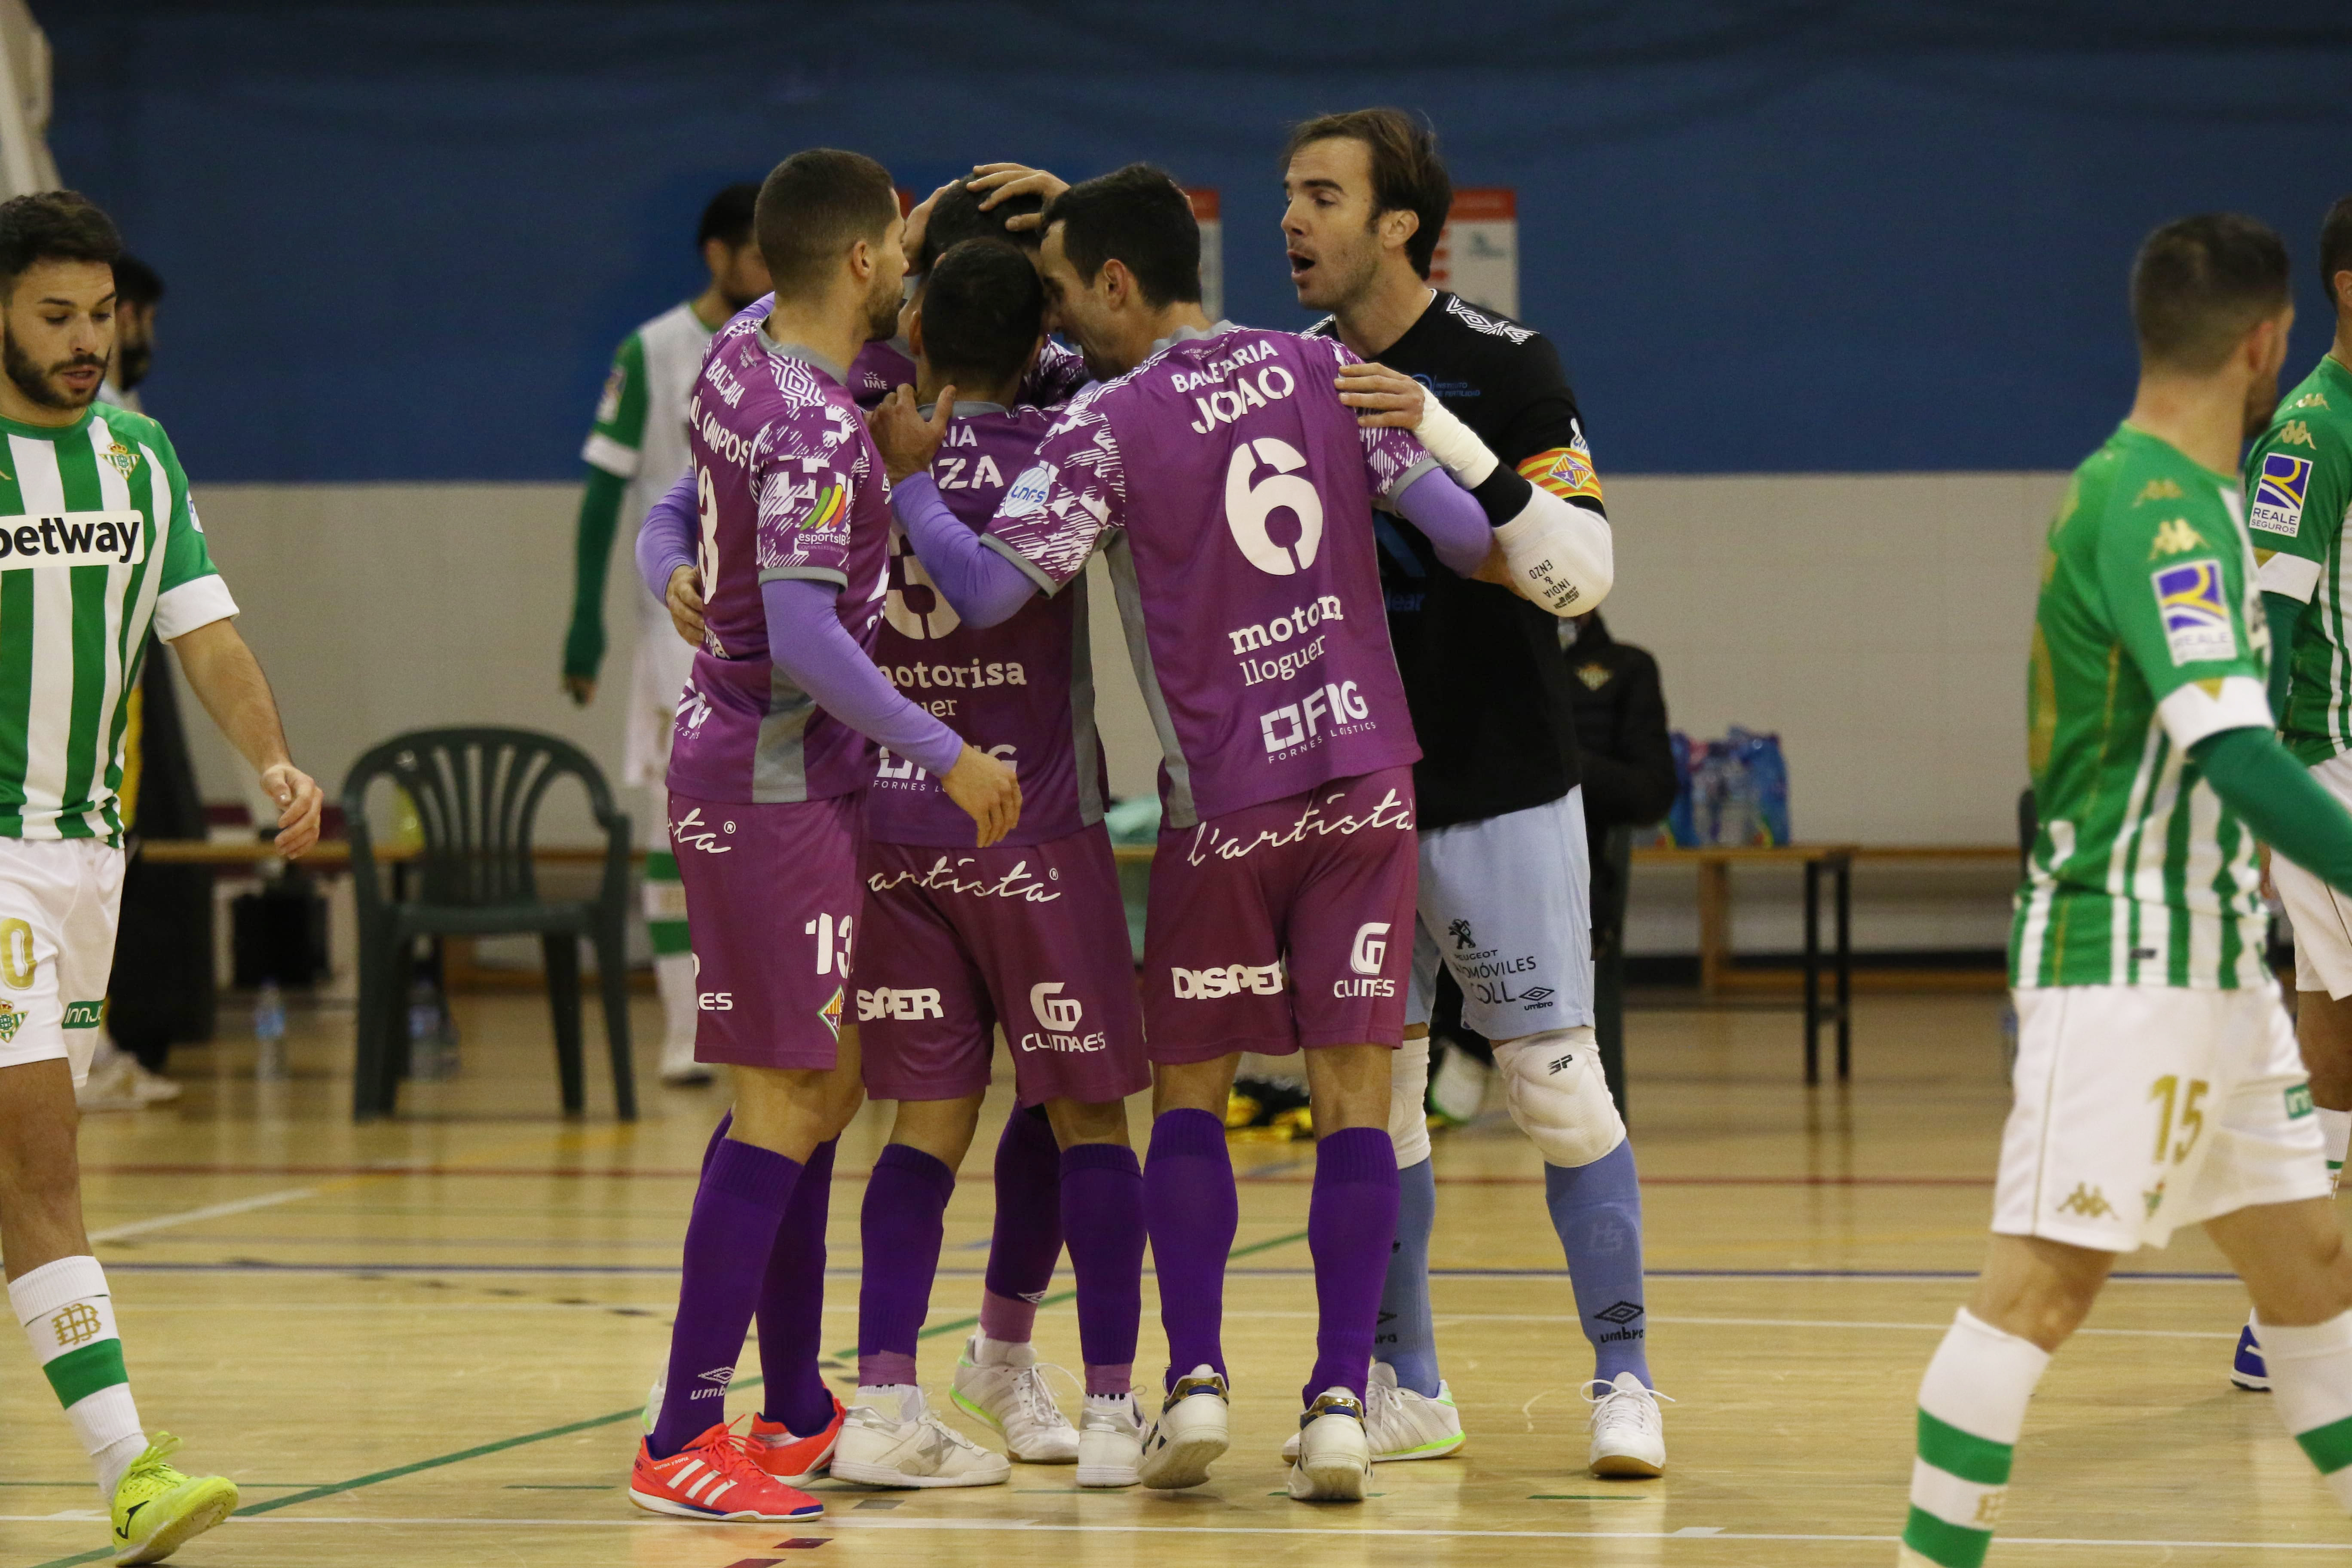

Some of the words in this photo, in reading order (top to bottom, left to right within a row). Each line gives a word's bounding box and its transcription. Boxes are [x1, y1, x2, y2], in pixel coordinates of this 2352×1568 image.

[1191, 366, 1295, 434] JOAO
[928, 455, 1004, 490] ZA
[1225, 437, 1323, 576] 6
[2253, 508, 2298, 525] REALE
[2251, 519, 2296, 534] SEGUROS
[1529, 560, 1553, 579] ENZO
[1544, 576, 1553, 585] &
[1543, 578, 1571, 598] INDIA
[1239, 634, 1326, 687] lloguer
[1268, 735, 1323, 764] FORNES
[873, 780, 926, 792] FORNES
[805, 913, 853, 979] 13
[1171, 960, 1283, 1000] DISPE
[1524, 1001, 1553, 1011] umbro
[2148, 1074, 2210, 1165] 15
